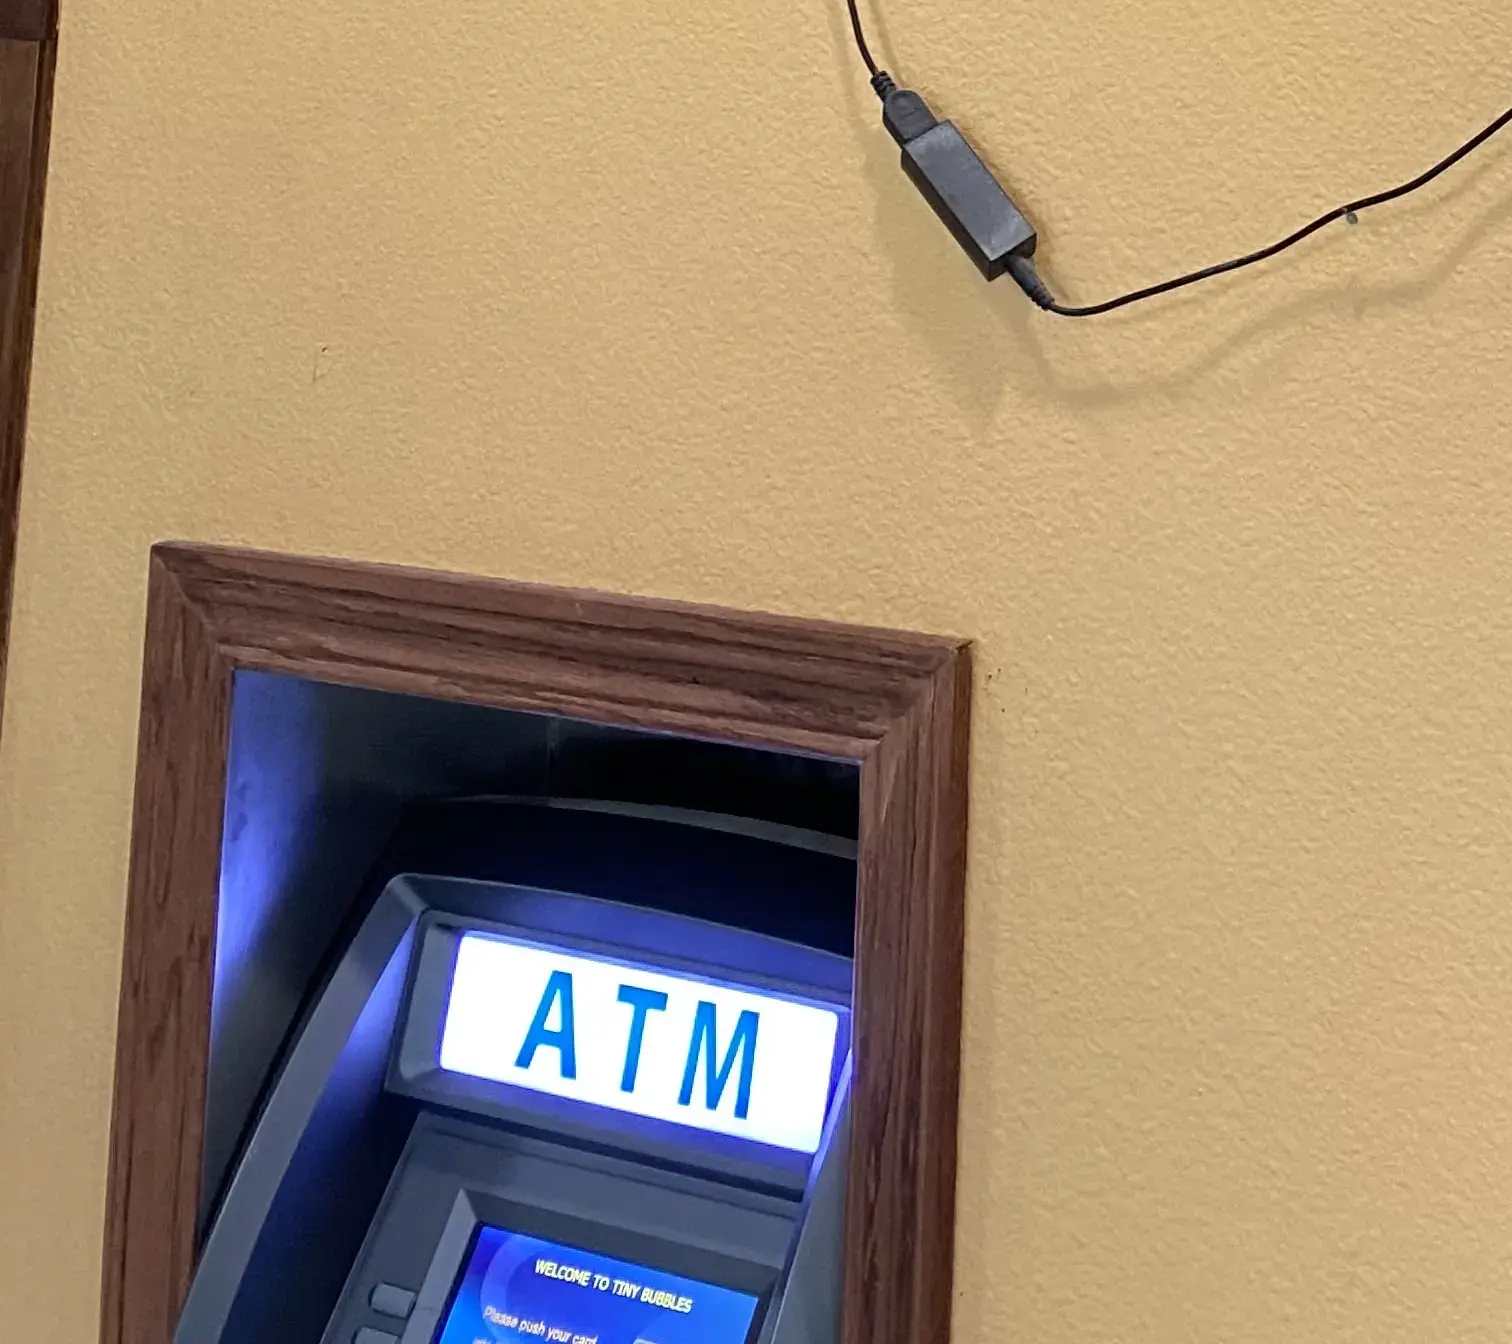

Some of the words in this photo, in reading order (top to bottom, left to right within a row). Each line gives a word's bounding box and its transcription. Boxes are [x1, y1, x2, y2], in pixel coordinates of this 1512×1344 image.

[513, 968, 762, 1121] ATM
[534, 1258, 591, 1287] WELCOME
[593, 1273, 610, 1292] TO
[612, 1278, 642, 1300] TINY
[641, 1286, 694, 1315] BUBBLES
[483, 1304, 518, 1329] Please
[518, 1316, 546, 1338] push
[548, 1325, 573, 1344] your
